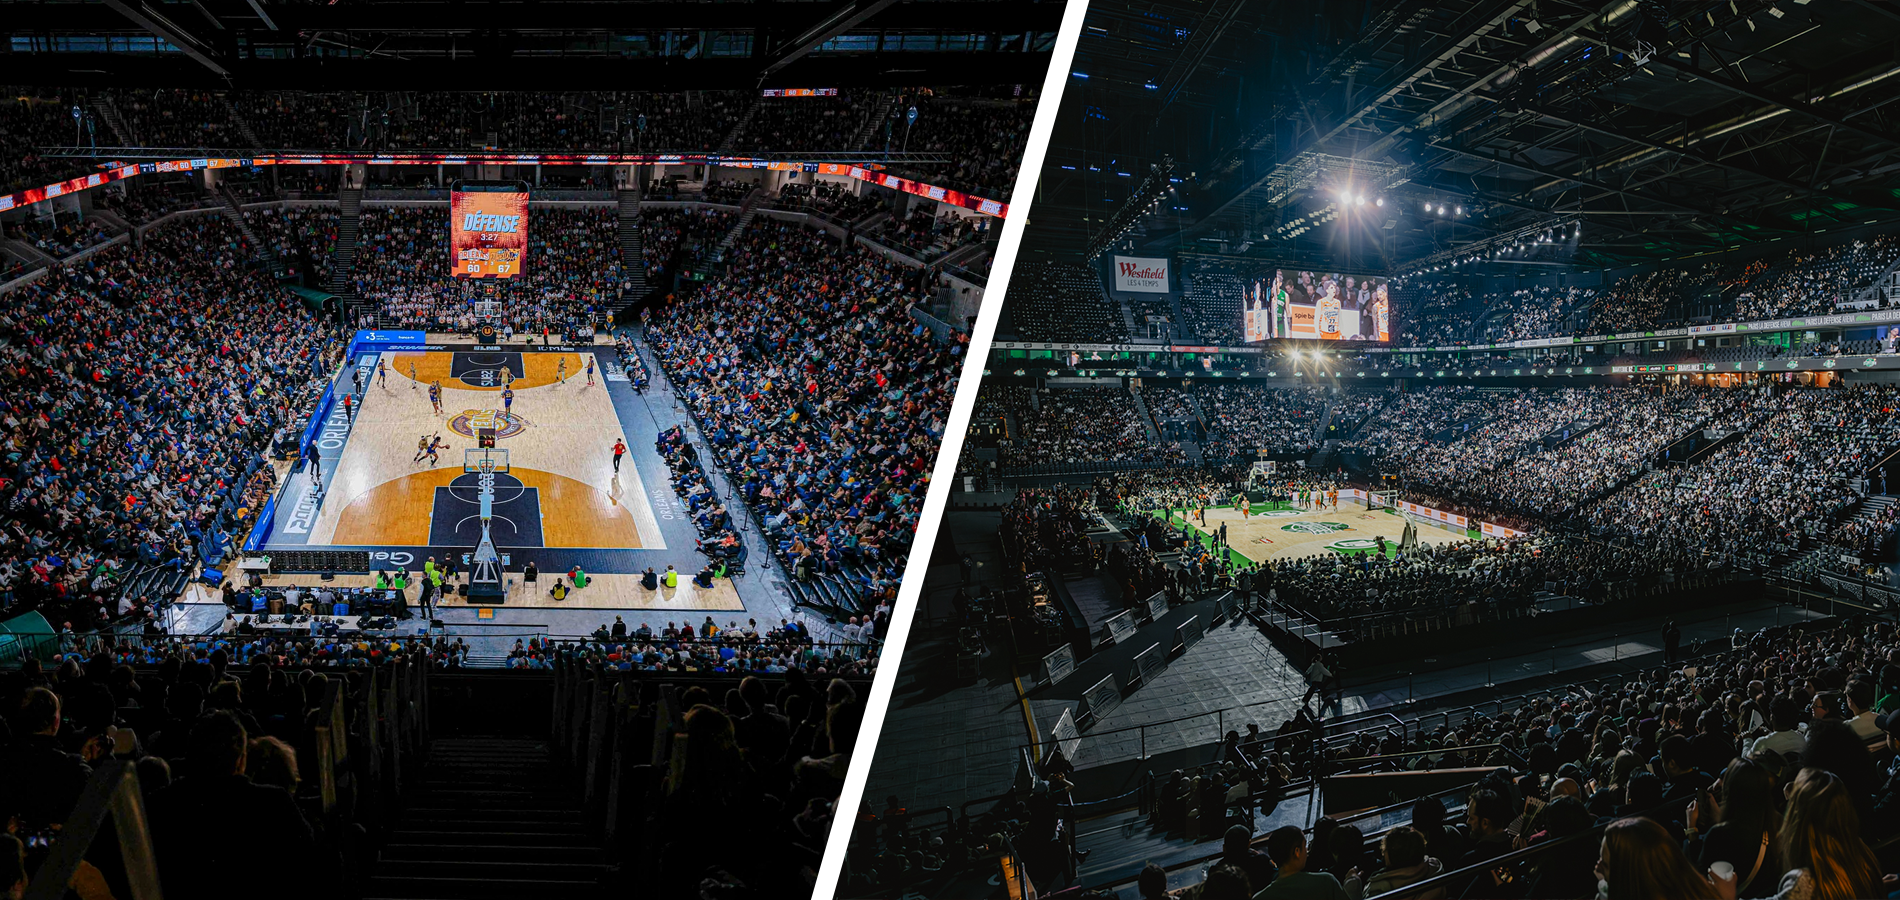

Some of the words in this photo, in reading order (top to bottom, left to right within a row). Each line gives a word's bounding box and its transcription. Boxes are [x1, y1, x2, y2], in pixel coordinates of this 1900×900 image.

[463, 209, 520, 233] DÉFENSE
[480, 233, 499, 241] 3:27
[467, 264, 480, 272] 60
[498, 264, 511, 272] 67
[1118, 261, 1166, 279] Westfield
[1127, 279, 1137, 287] LES
[1294, 312, 1307, 320] spie
[1871, 312, 1885, 320] PARIS
[1886, 311, 1892, 320] LA
[1805, 317, 1818, 326] PARIS
[1818, 317, 1823, 325] LA
[369, 332, 376, 341] 3
